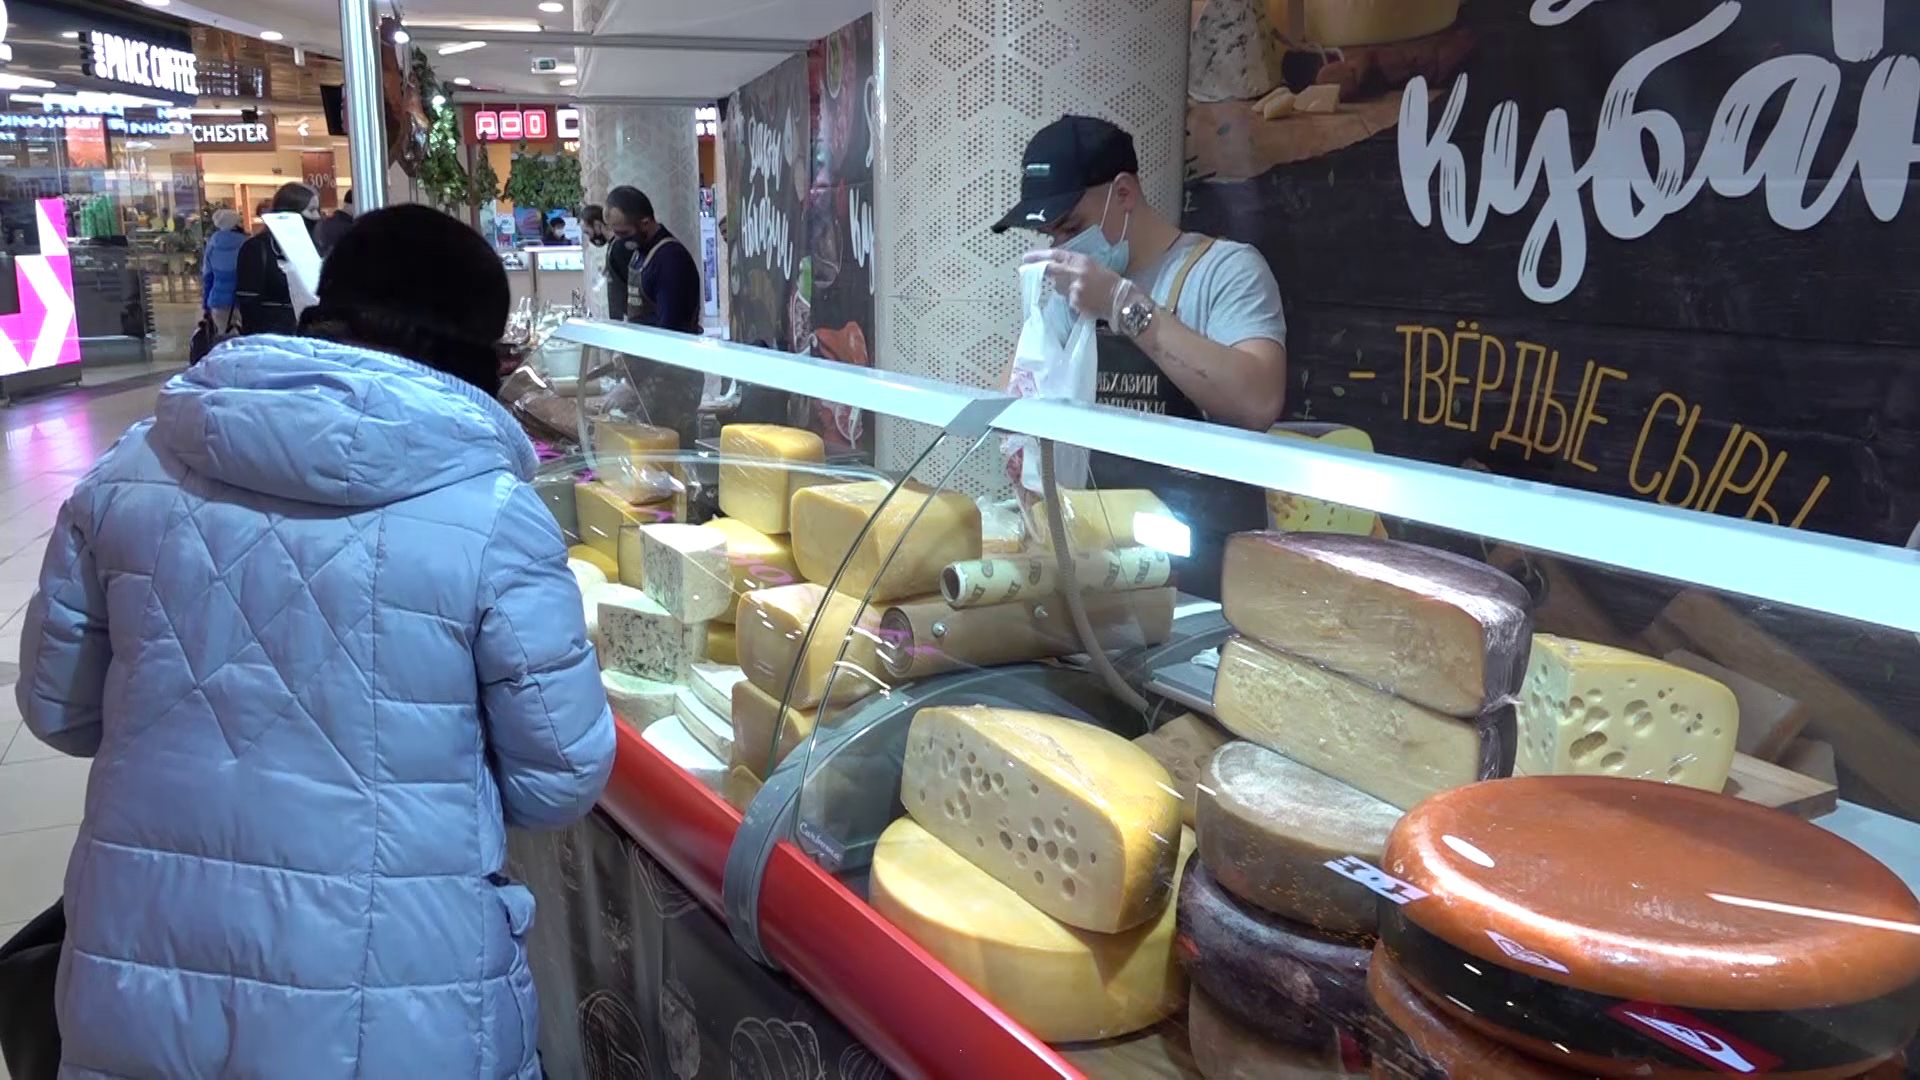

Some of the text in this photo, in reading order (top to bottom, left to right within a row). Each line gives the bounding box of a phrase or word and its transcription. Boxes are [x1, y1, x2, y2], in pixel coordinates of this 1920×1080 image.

[104, 33, 152, 87] PRICE
[150, 44, 199, 95] COFFEE
[192, 123, 269, 143] CHESTER
[1396, 320, 1628, 472] ТВЁРДЫЕ
